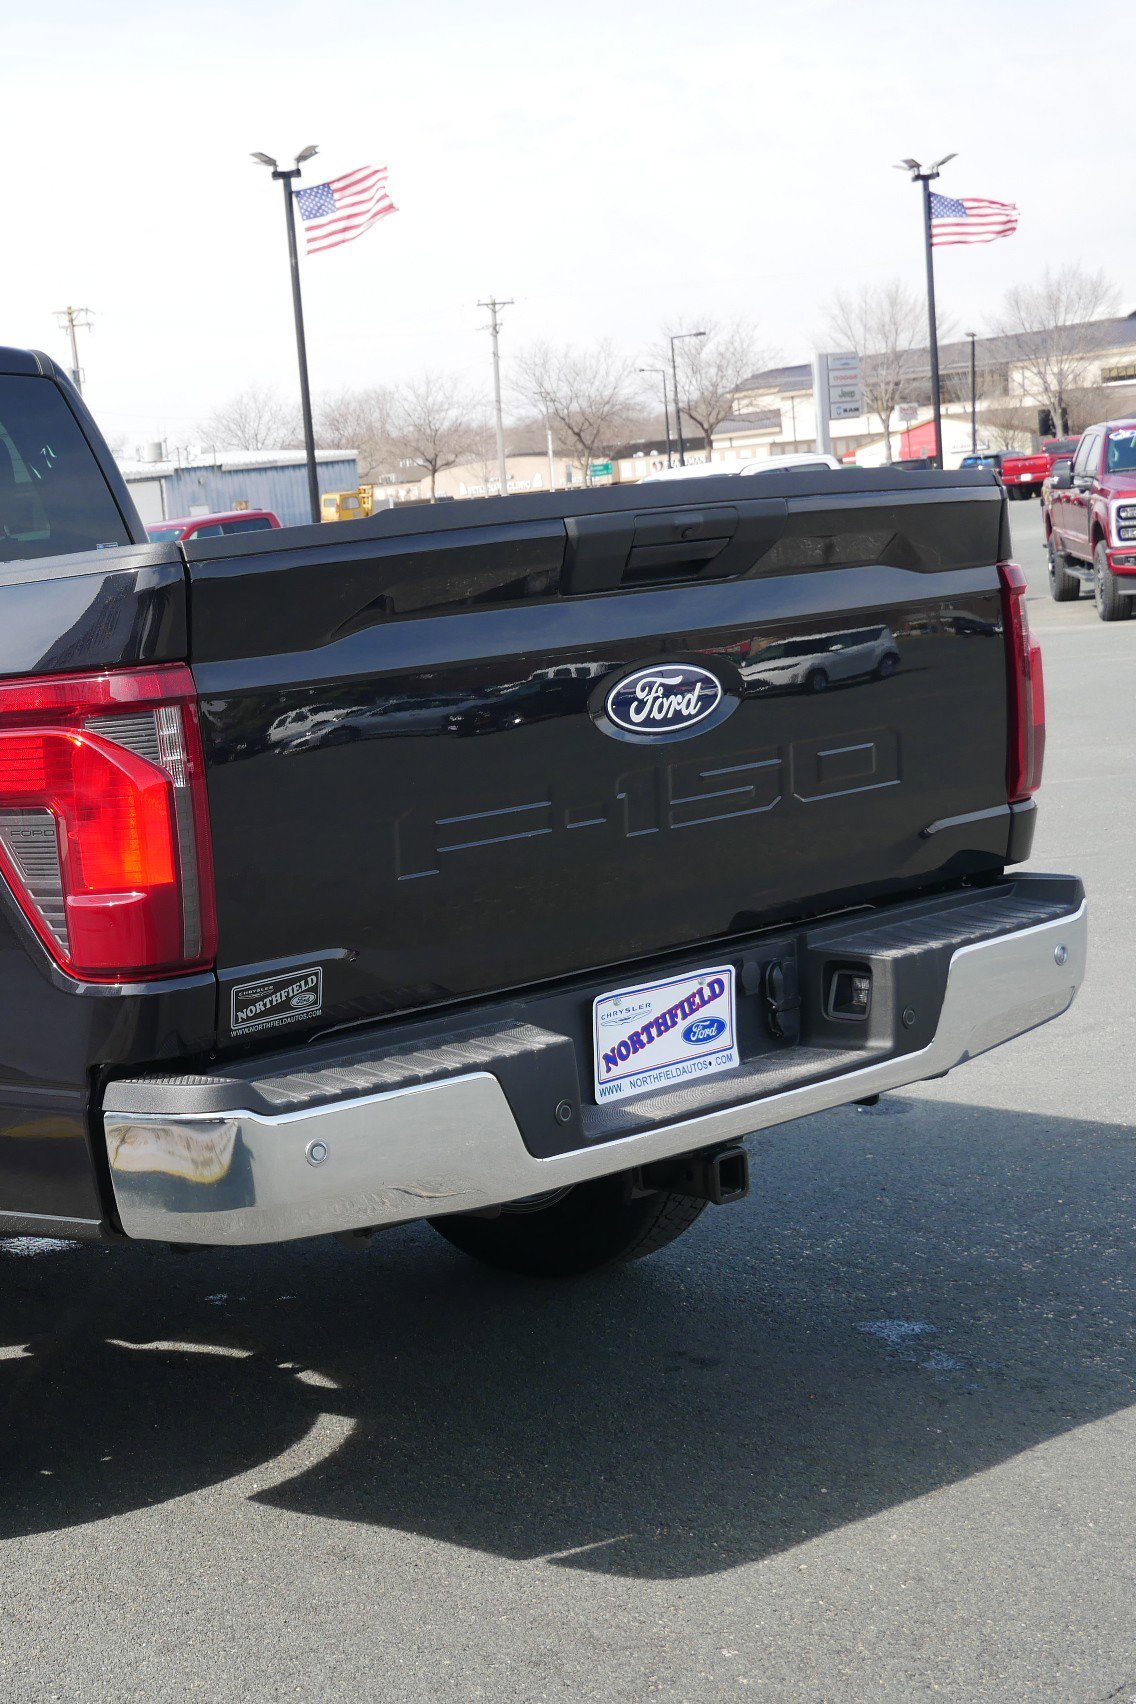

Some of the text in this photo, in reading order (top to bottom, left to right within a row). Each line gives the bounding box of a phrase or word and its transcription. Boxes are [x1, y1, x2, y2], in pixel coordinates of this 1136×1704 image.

[630, 674, 702, 723] Ford
[395, 724, 903, 881] F-150
[237, 975, 317, 1022] NORTHFIELD
[601, 1002, 652, 1020] CHRYSLER
[602, 977, 725, 1073] NORTHFIELD
